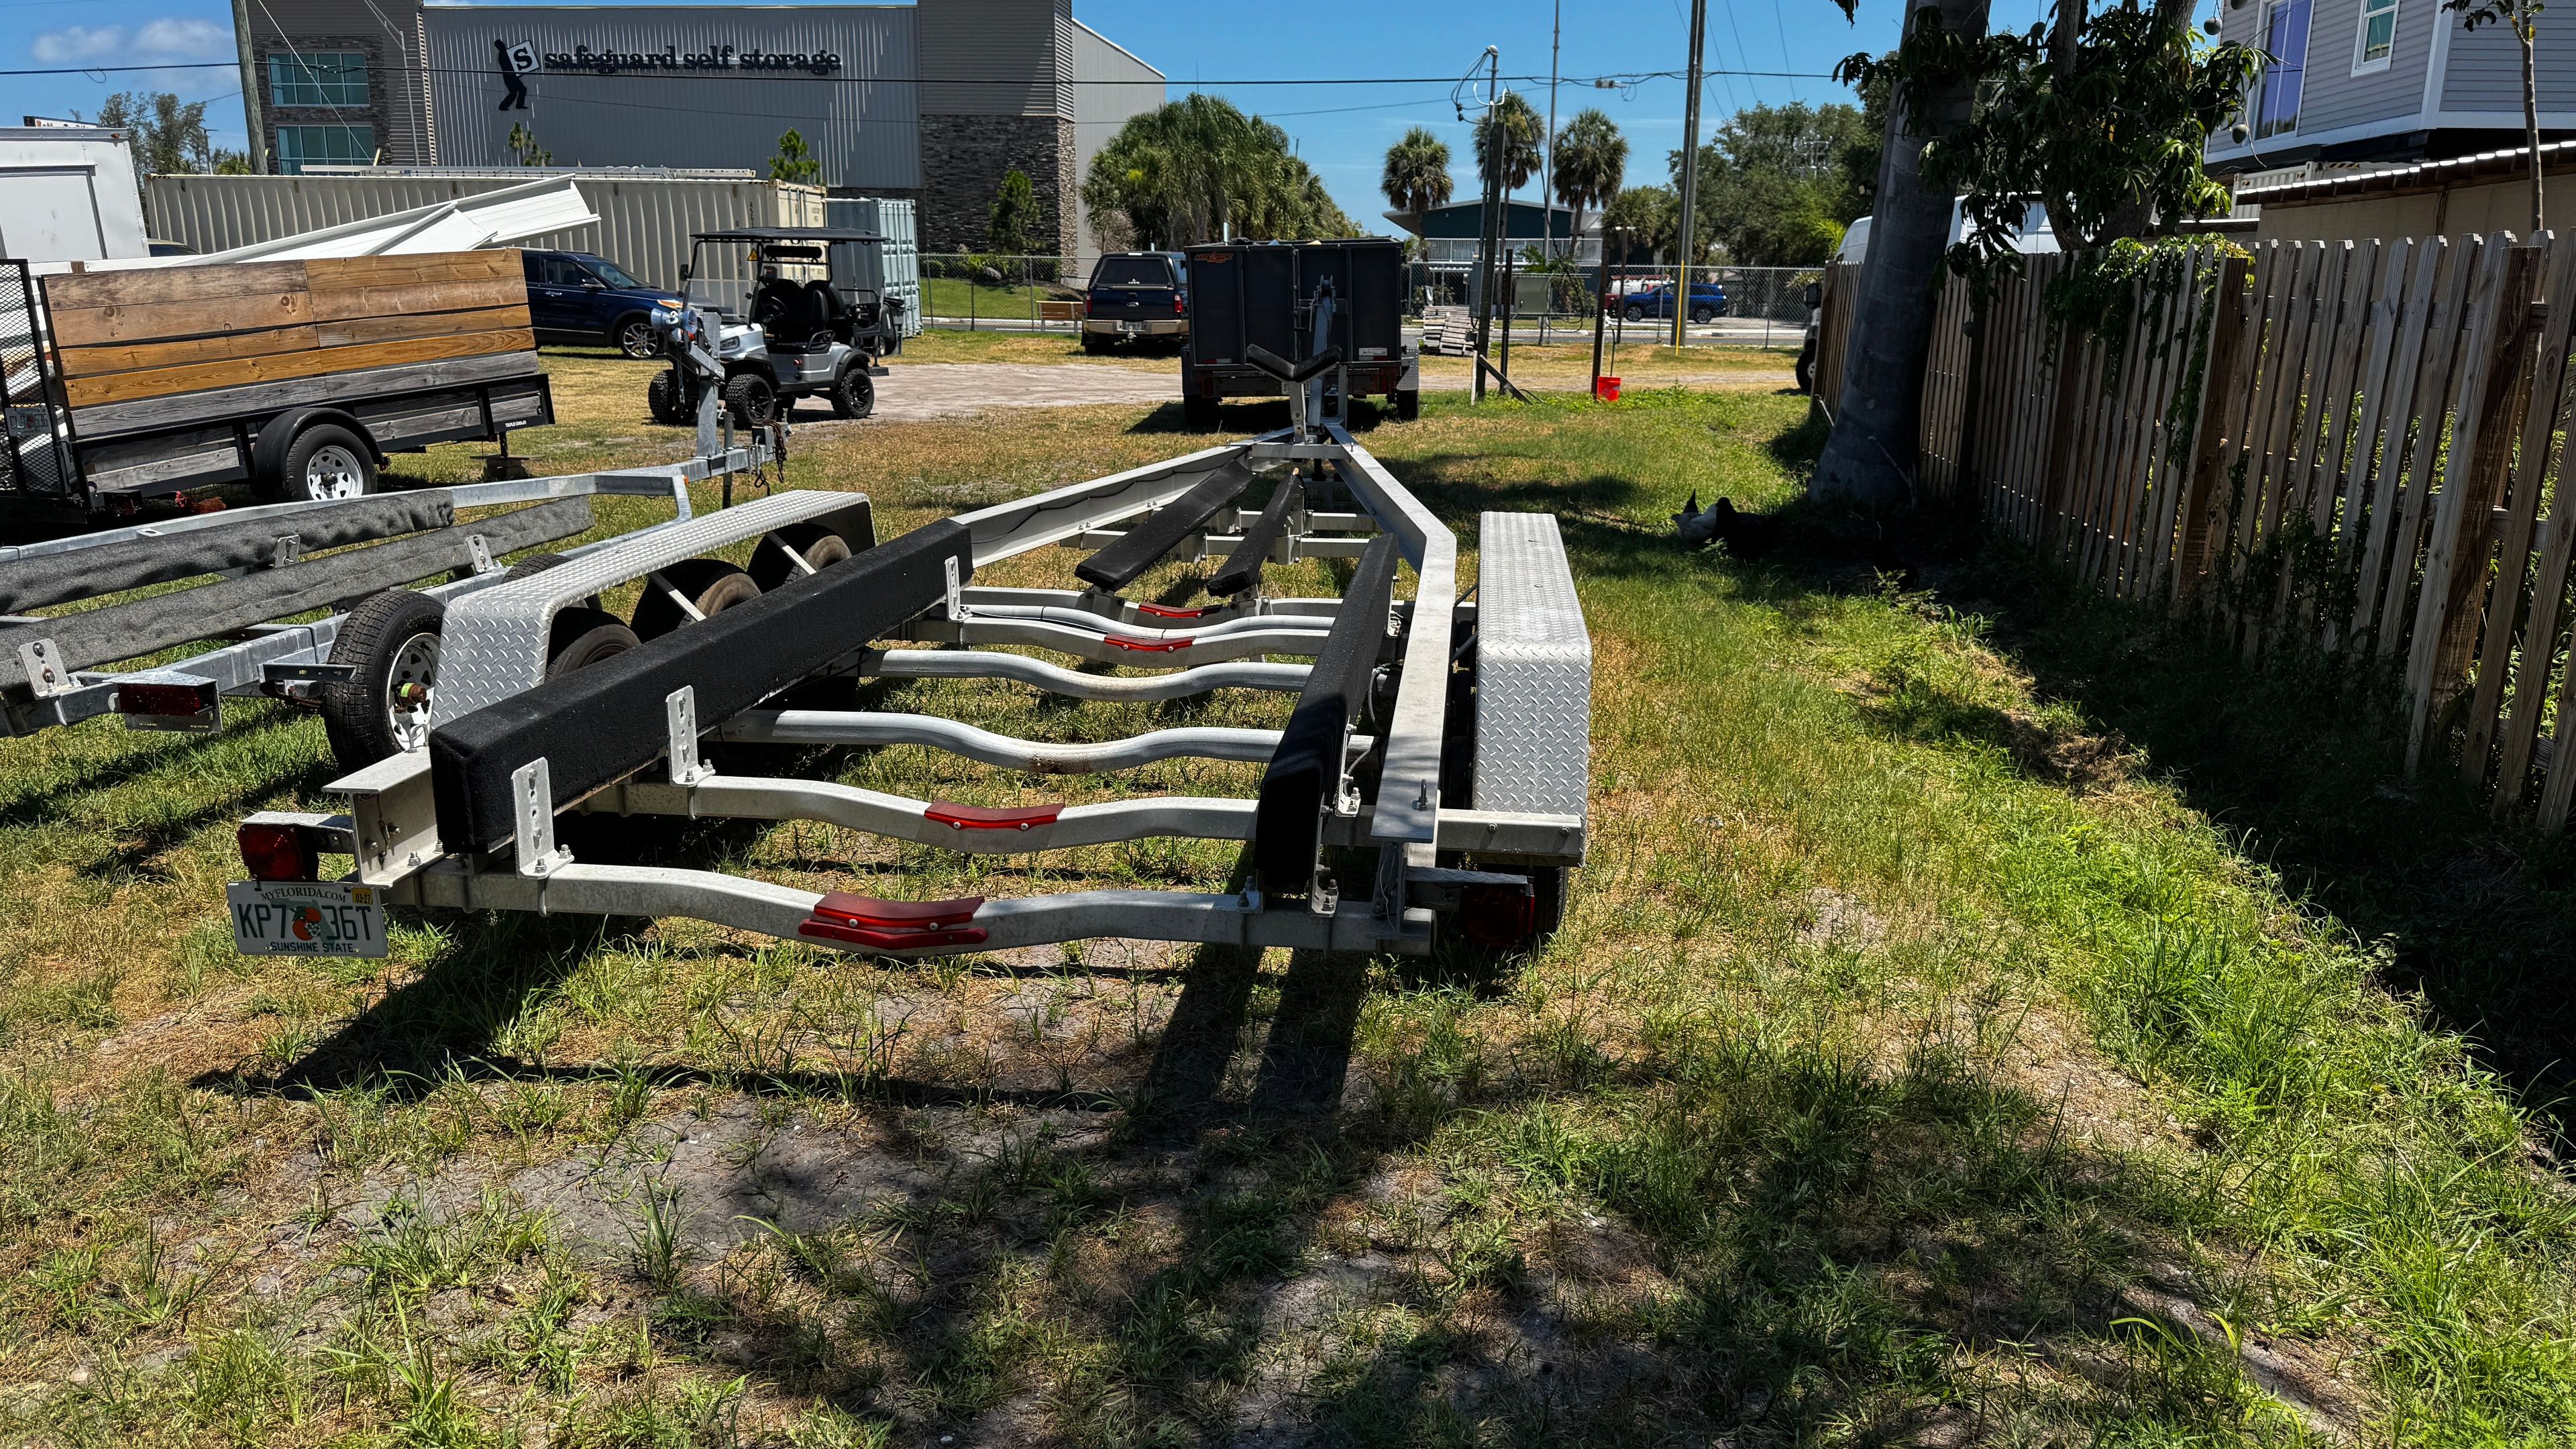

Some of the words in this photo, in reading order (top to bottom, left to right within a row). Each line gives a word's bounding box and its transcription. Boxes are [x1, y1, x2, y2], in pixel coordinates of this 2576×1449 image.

[513, 47, 533, 70] S
[544, 45, 679, 74] safeguard
[683, 45, 734, 70] self
[739, 48, 842, 75] storage
[260, 887, 346, 902] MYFLORIDA.COM
[237, 904, 286, 938] KP7
[321, 906, 371, 941] 36T
[270, 941, 319, 952] SUNSHINE
[323, 943, 354, 953] STATE
